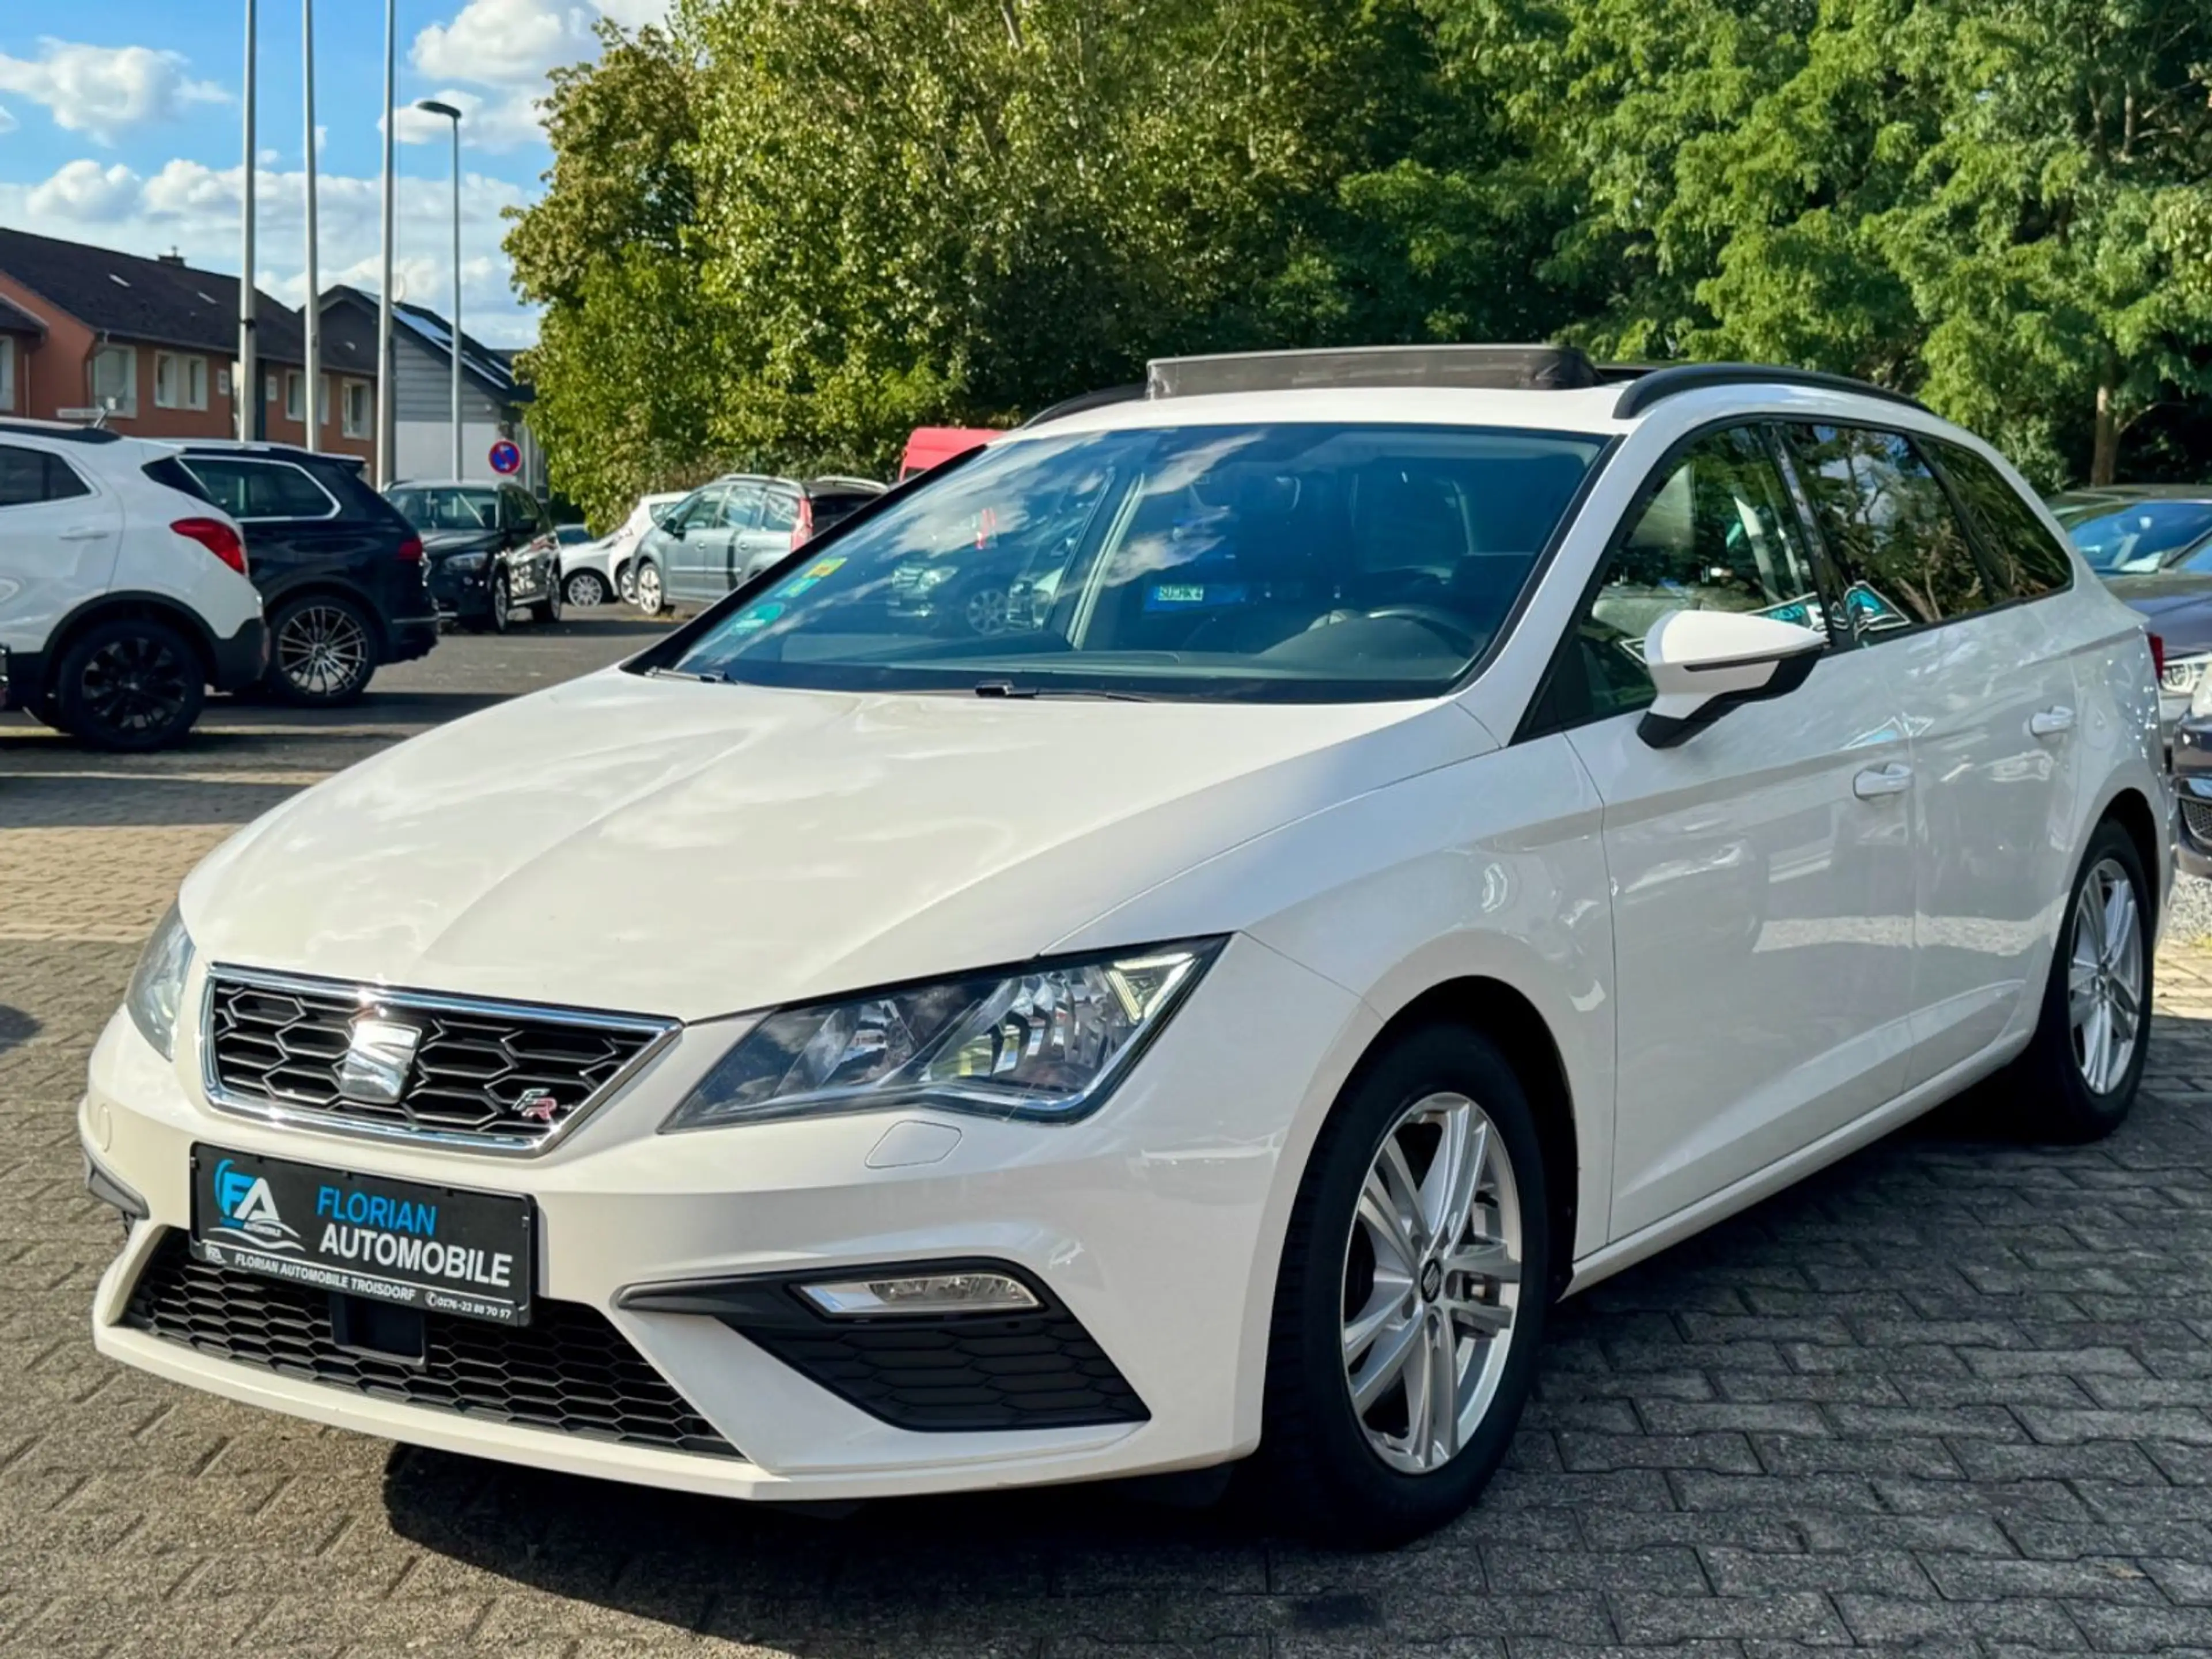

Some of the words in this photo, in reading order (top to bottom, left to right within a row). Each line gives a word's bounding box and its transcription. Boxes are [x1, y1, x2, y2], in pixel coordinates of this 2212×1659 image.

[221, 1172, 281, 1221] FA
[317, 1185, 437, 1235] FLORIAN
[235, 1253, 279, 1273] FLORIAN
[280, 1264, 349, 1288] AUTOMOBILE
[351, 1277, 416, 1301] TROISDORF
[319, 1222, 513, 1287] AUTOMOBILE
